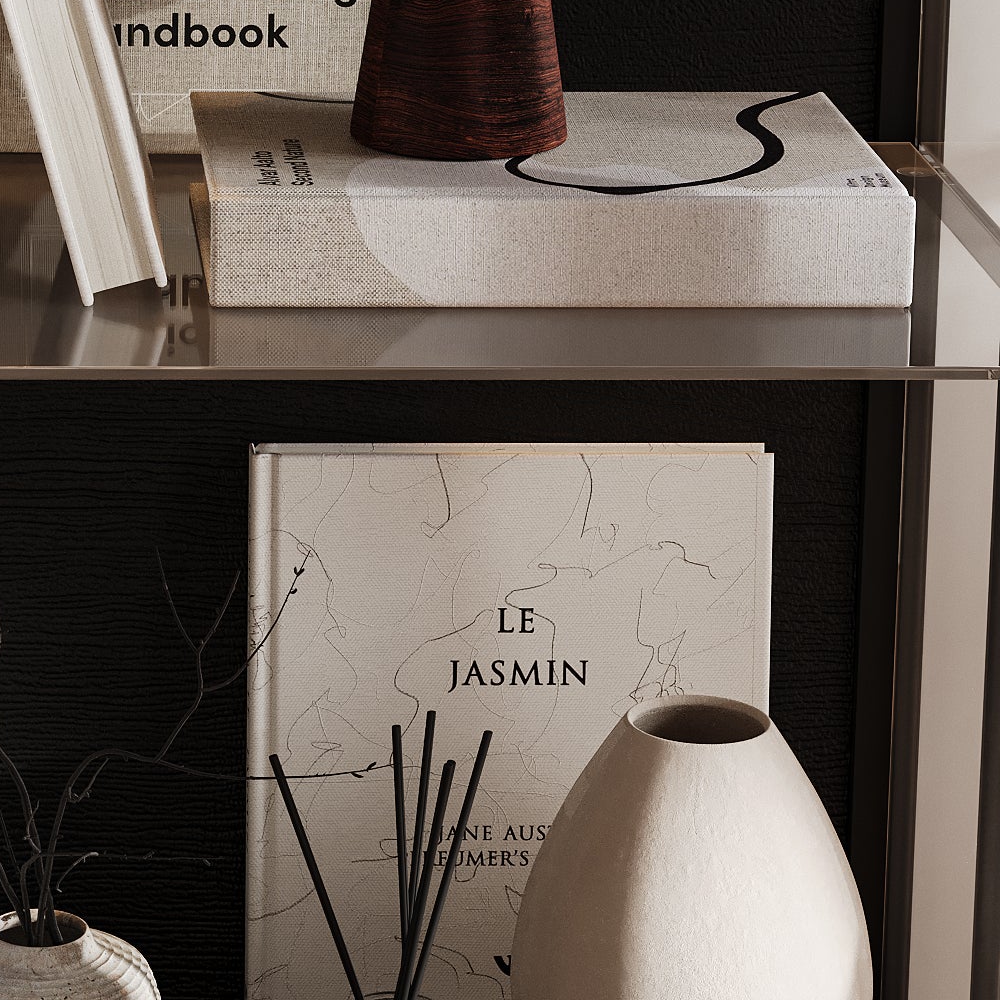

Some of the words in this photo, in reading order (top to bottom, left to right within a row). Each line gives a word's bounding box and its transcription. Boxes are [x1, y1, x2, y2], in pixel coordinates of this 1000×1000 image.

[250, 150, 276, 168] Aalto
[282, 138, 306, 160] Nature
[256, 168, 282, 186] Alvar
[284, 162, 314, 186] Second
[497, 607, 535, 634] LE
[448, 659, 589, 693] JASMIN
[503, 825, 552, 841] AUS
